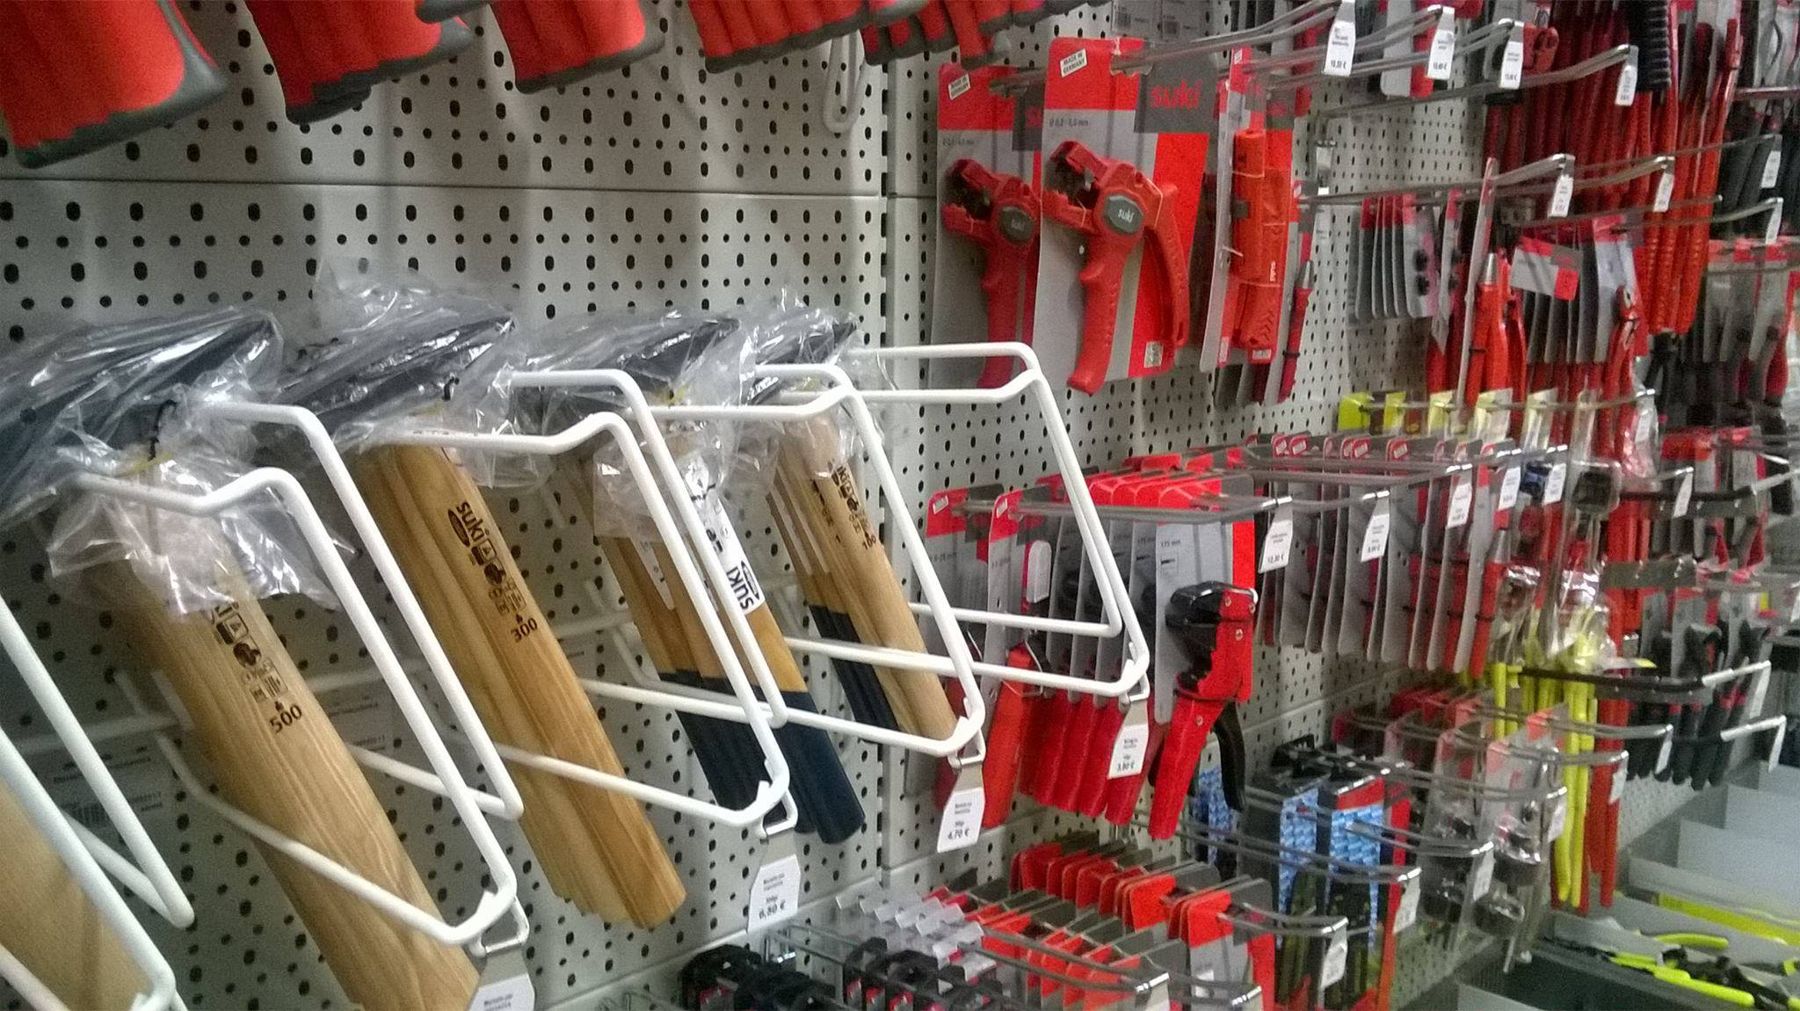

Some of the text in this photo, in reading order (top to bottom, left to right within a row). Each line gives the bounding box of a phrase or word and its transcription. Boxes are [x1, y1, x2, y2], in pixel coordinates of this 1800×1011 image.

[1152, 79, 1203, 112] suki
[862, 533, 877, 550] 100
[510, 617, 538, 643] 300
[269, 703, 303, 734] 500
